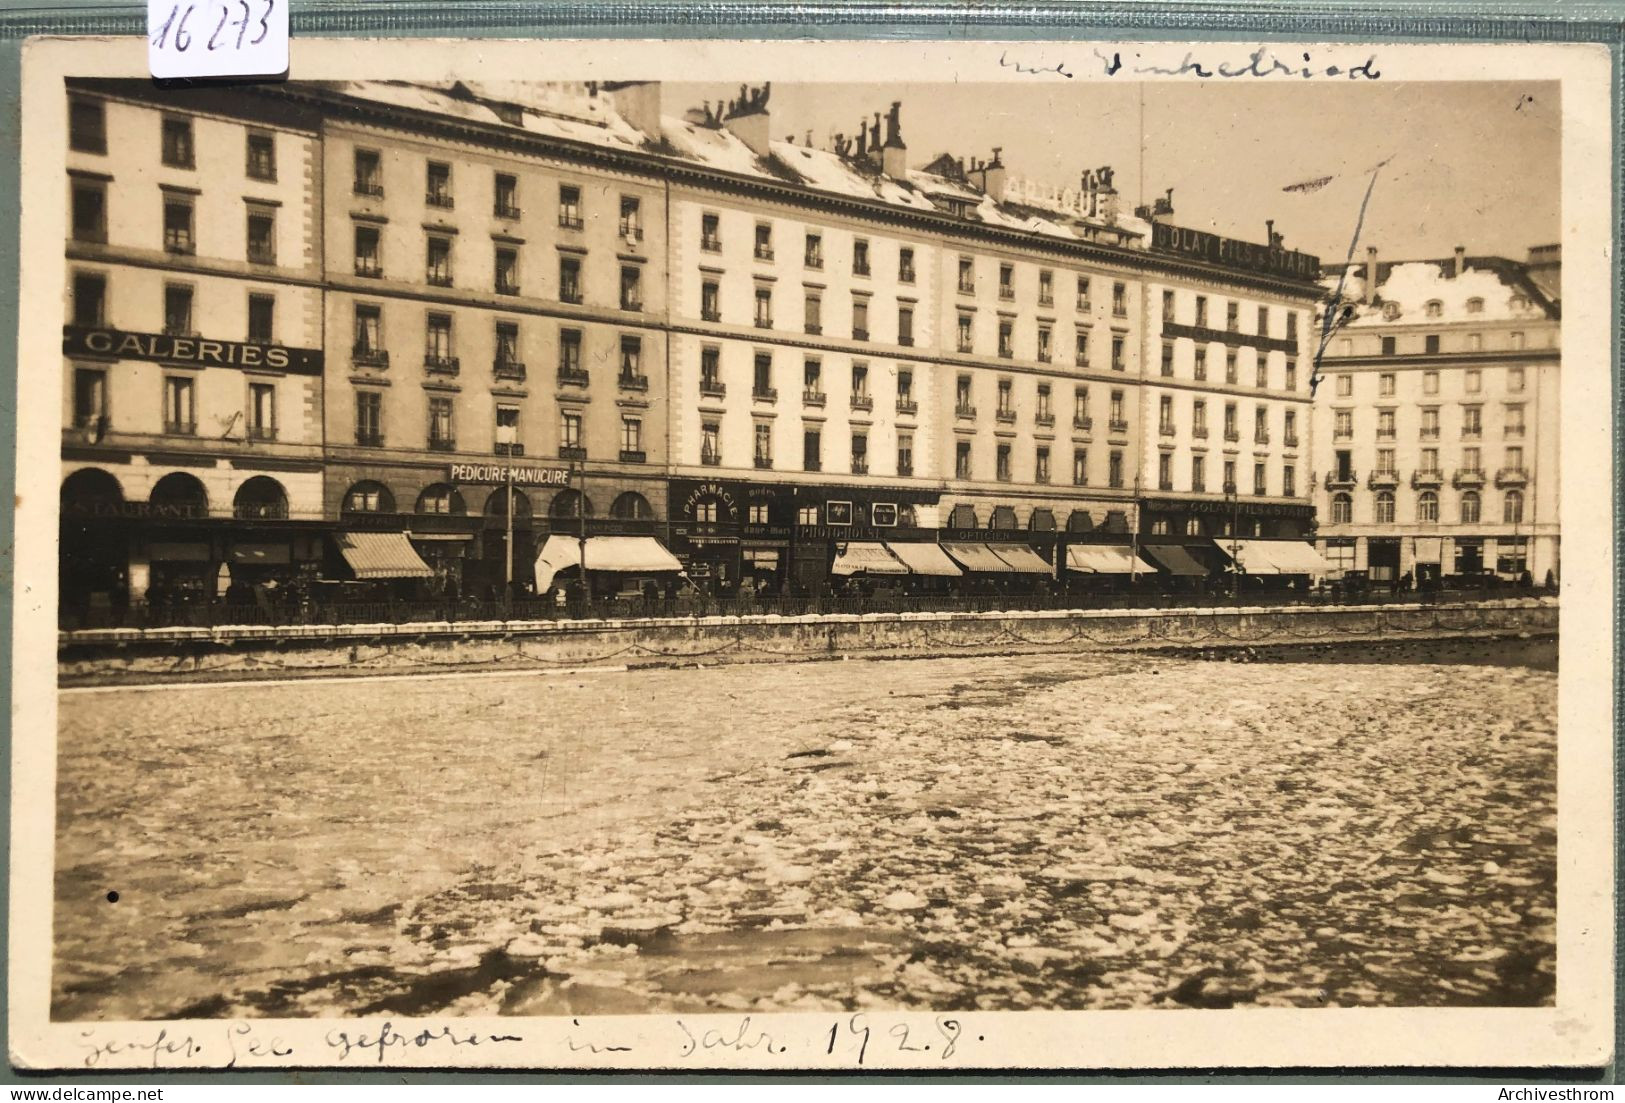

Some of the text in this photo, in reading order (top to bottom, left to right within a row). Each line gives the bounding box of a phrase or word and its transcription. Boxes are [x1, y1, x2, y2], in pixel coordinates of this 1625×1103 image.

[152, 0, 274, 52] 16 273
[1157, 224, 1211, 254] GOLAY
[1219, 237, 1253, 263] FILS
[1270, 249, 1315, 275] STAHL
[85, 331, 289, 368] GALERIES
[683, 484, 738, 516] PHARMACIE
[1190, 502, 1232, 513] GOLAY
[959, 531, 1010, 541] OPTICIEN
